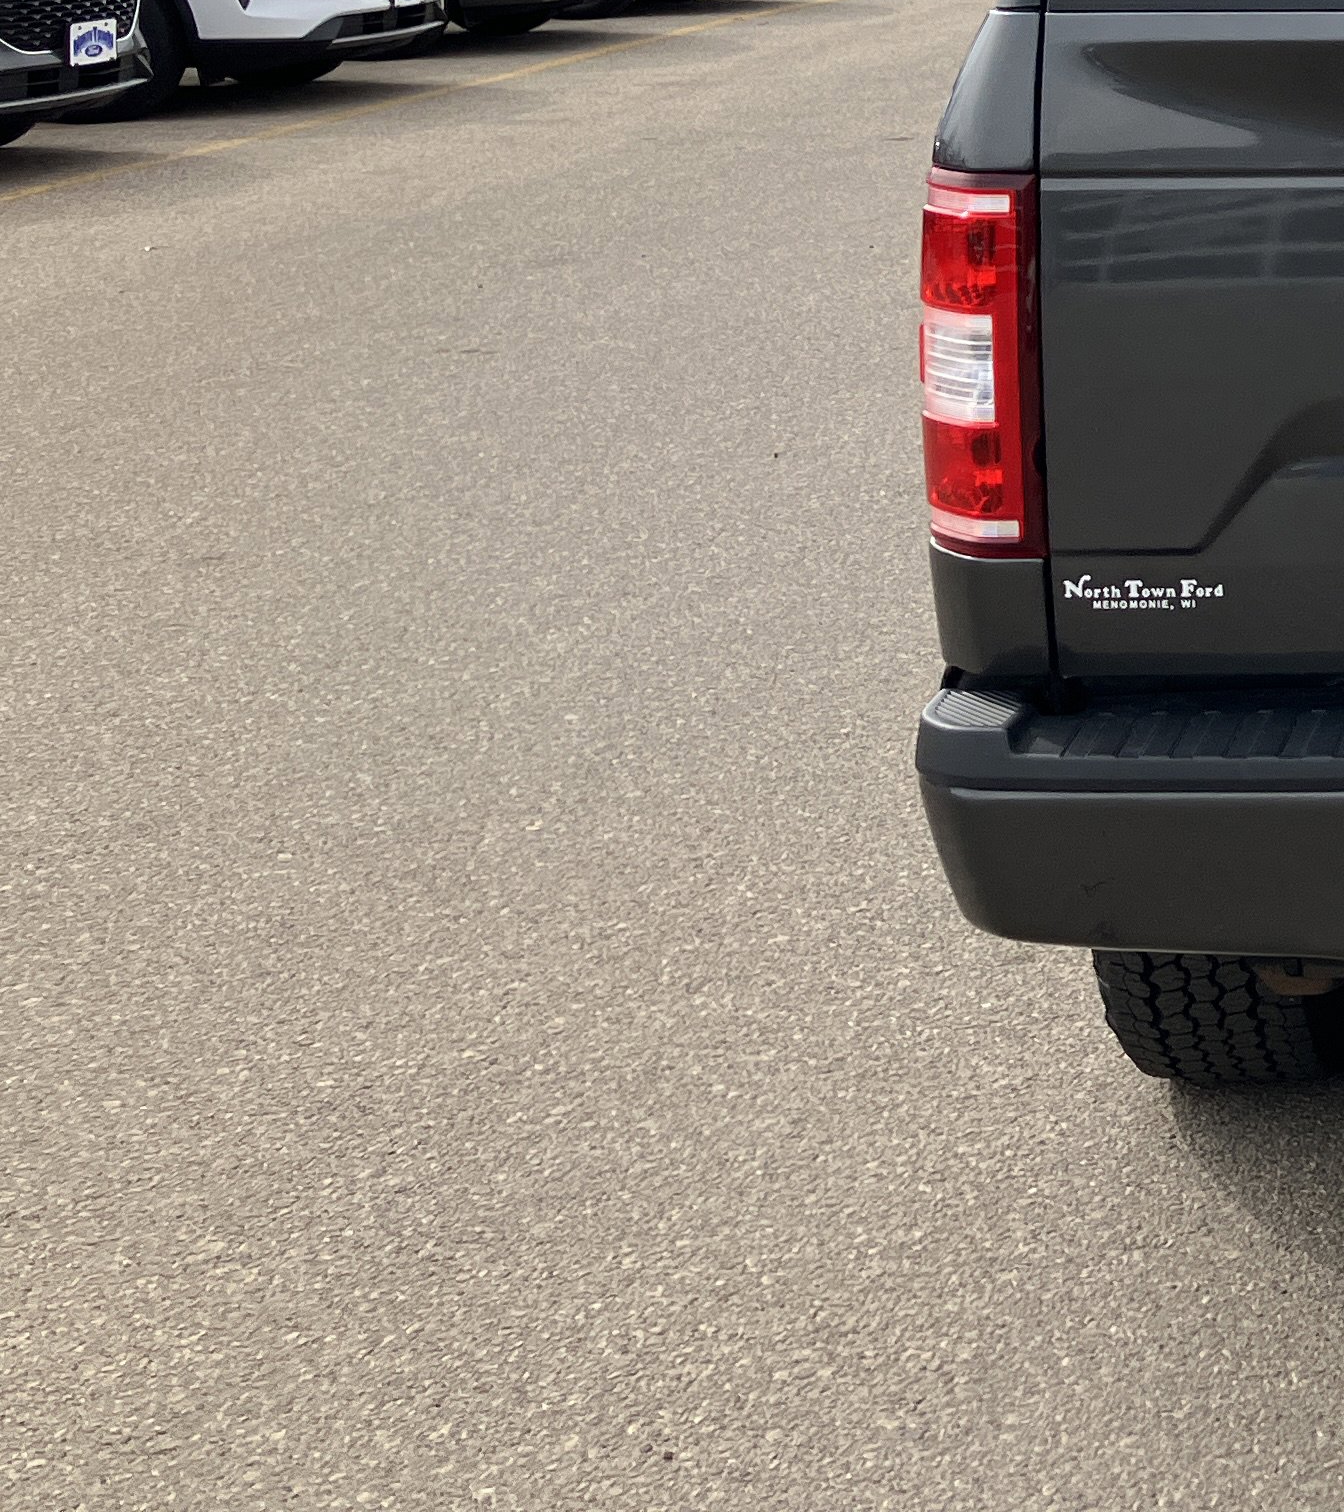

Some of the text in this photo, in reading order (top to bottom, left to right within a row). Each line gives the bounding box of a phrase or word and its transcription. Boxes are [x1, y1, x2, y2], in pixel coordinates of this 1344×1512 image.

[1063, 574, 1225, 598] North Town Ford
[1092, 599, 1197, 610] MENOMONIE, WI
